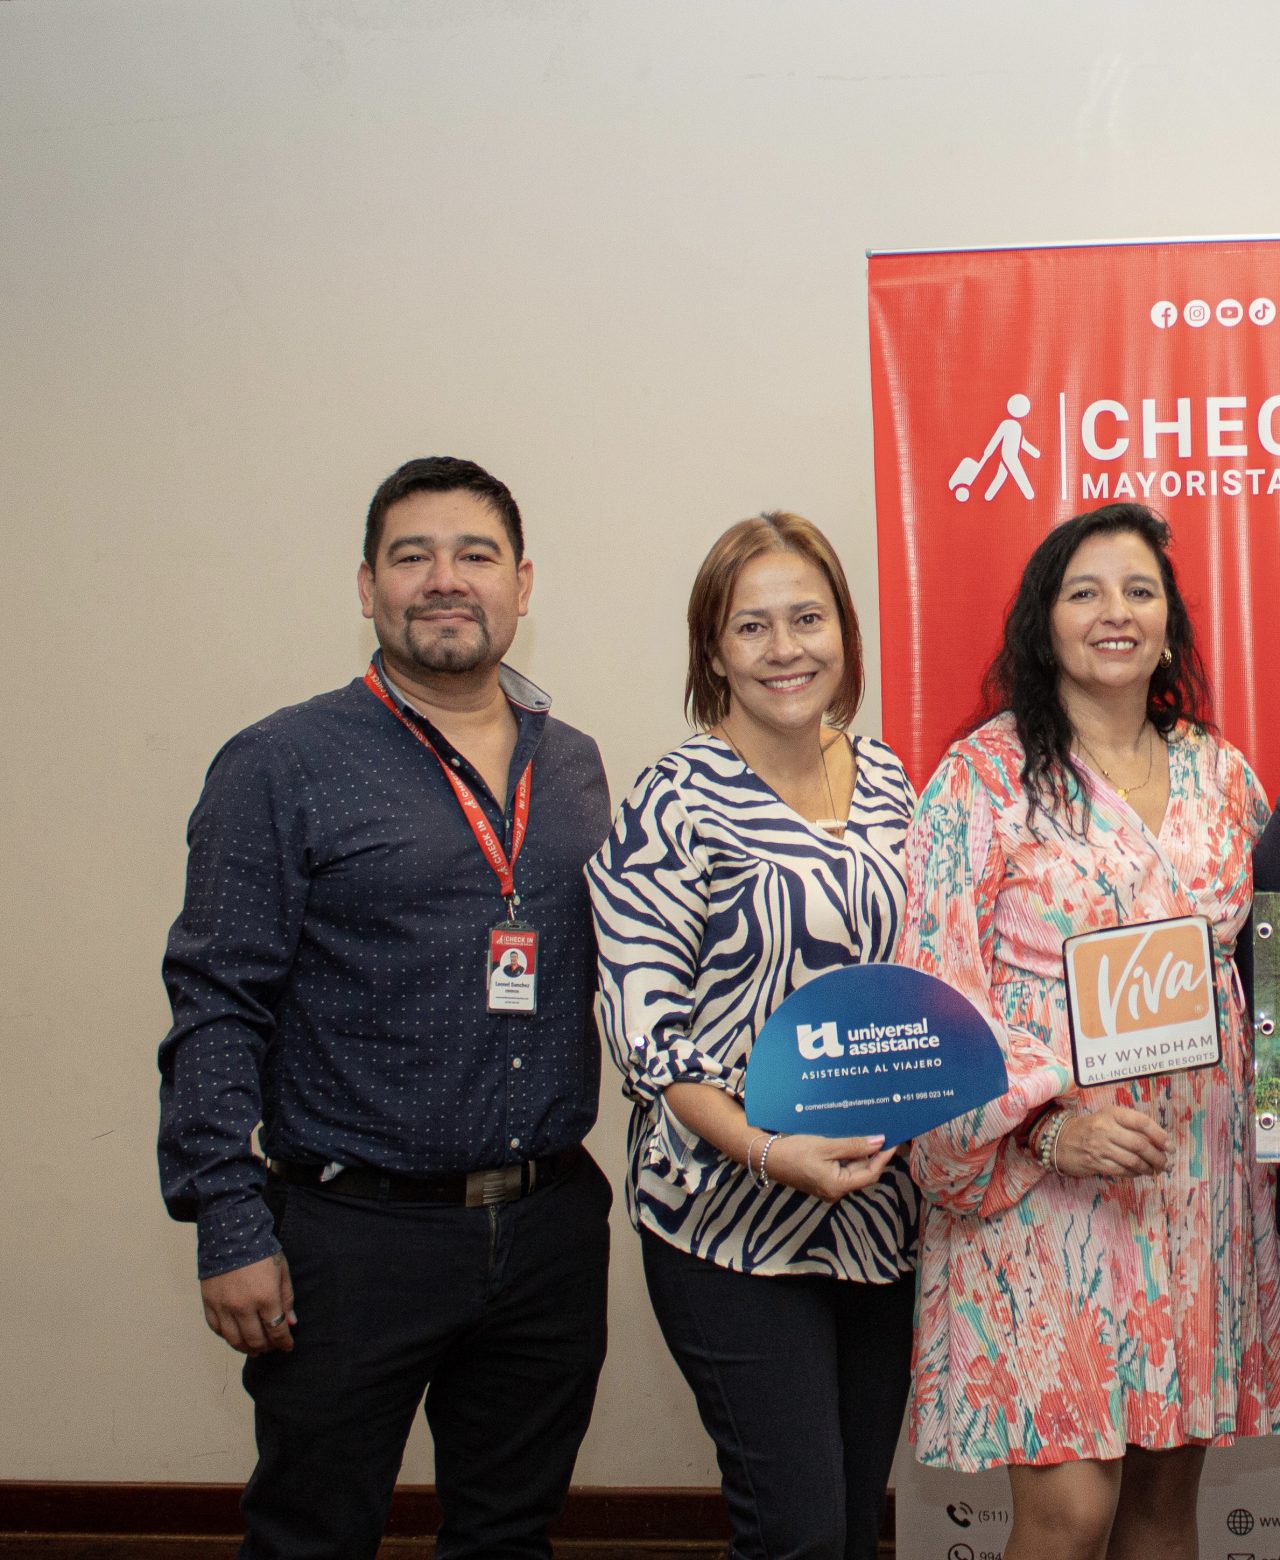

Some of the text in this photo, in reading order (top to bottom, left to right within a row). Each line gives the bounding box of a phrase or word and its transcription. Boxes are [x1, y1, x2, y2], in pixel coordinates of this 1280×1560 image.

[476, 819, 502, 865] CHECK IN
[1097, 929, 1207, 1038] Viva
[847, 1017, 929, 1042] universal
[848, 1034, 940, 1056] assistance
[1085, 1034, 1214, 1069] BY WYNDHAM
[801, 1058, 943, 1081] ASISTENCIA AL VIAJERO
[1087, 1051, 1216, 1083] ALL-INCLUSIVE RESORTS
[902, 1093, 914, 1102] +51
[928, 1091, 941, 1099] 023
[942, 1089, 954, 1098] 144
[978, 1510, 1009, 1524] (511)
